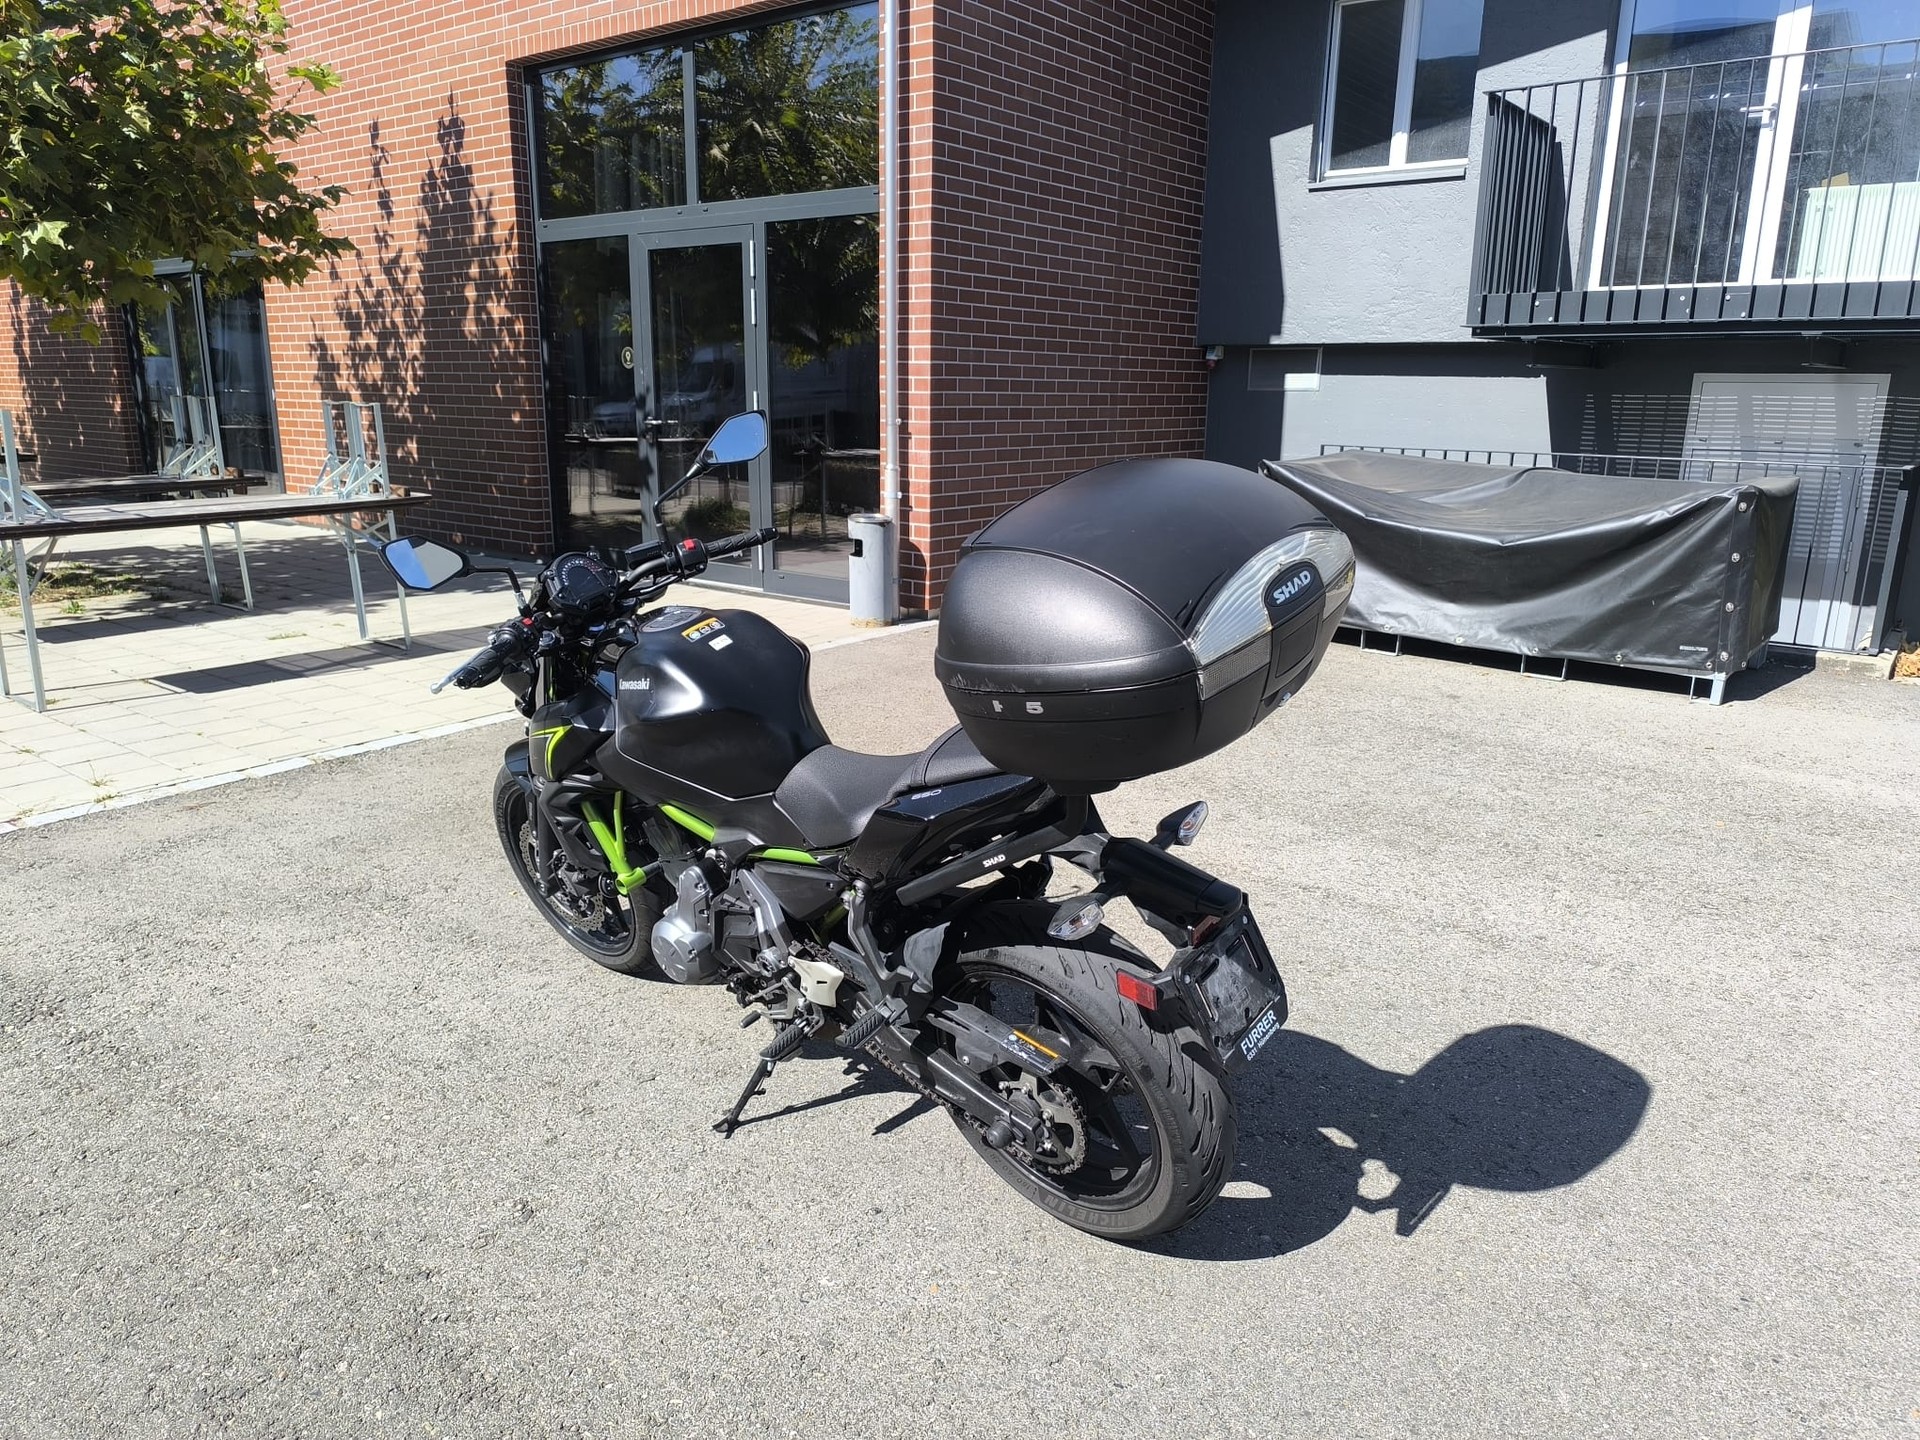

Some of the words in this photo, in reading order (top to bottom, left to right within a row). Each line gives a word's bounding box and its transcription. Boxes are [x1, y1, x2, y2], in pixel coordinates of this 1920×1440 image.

[1273, 570, 1311, 604] SHAD
[619, 677, 650, 690] Kawasaki
[982, 853, 1006, 868] SHAD
[1240, 1009, 1277, 1055] FURRER
[1044, 1193, 1129, 1227] MICHELIN
